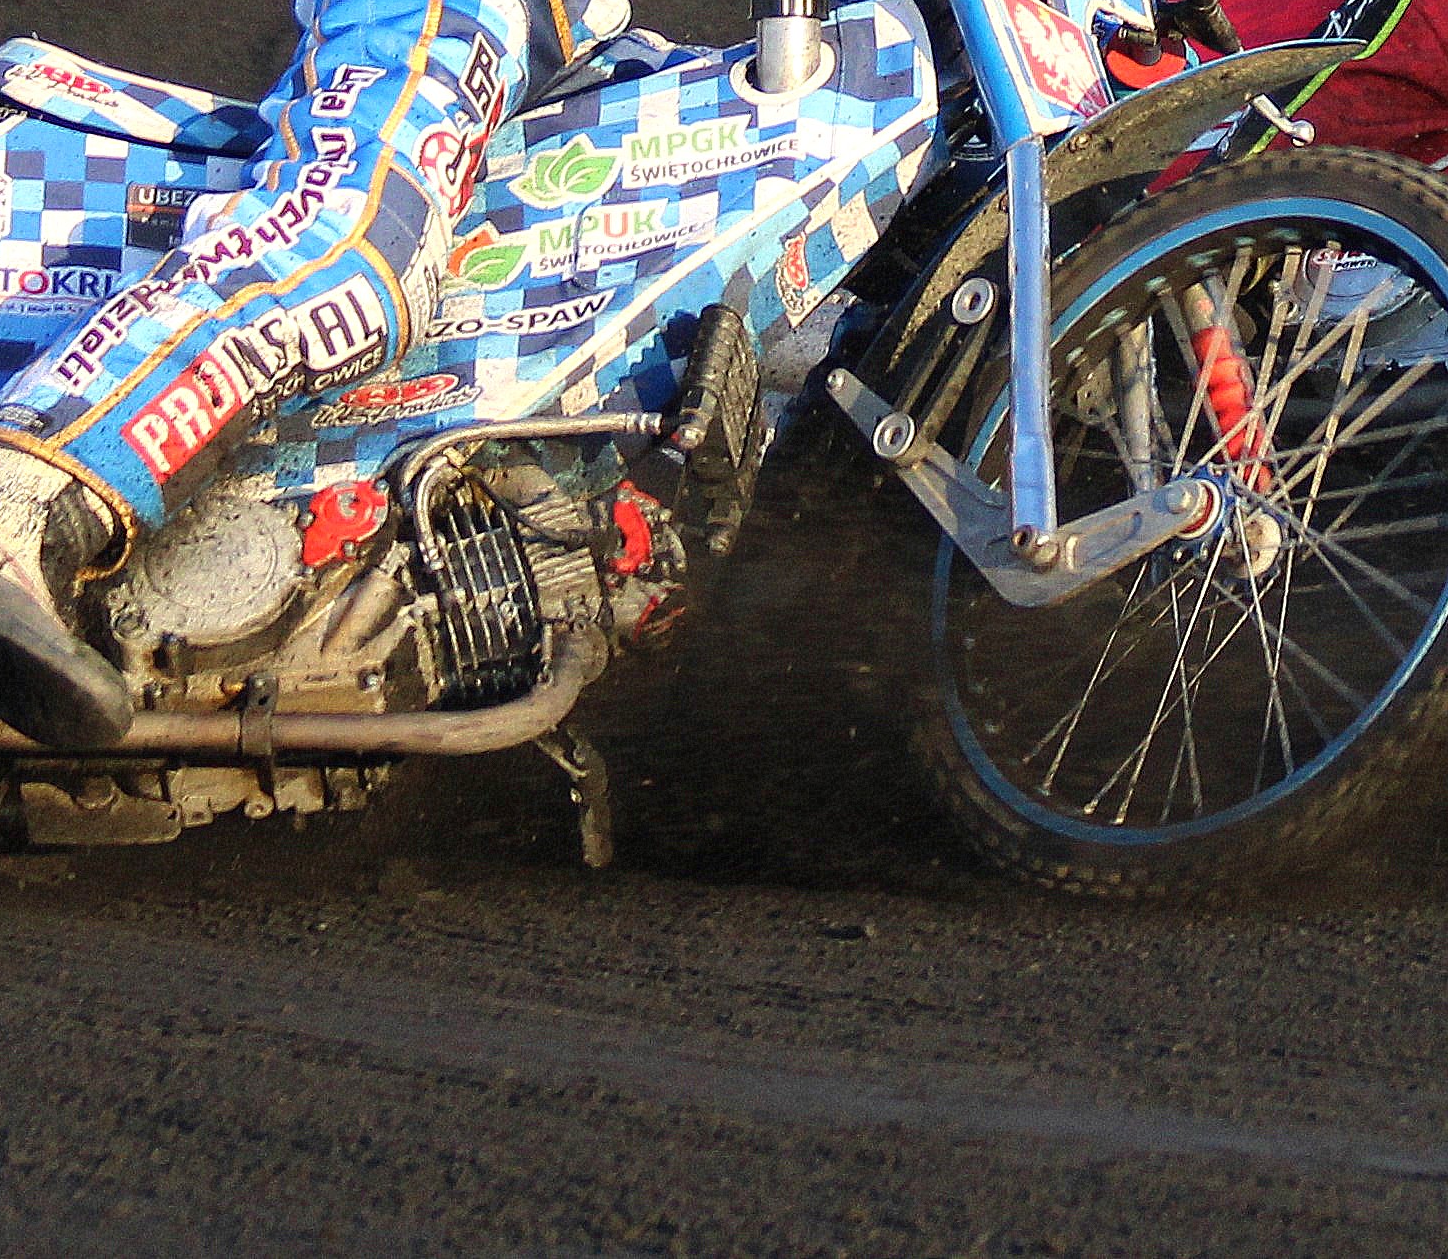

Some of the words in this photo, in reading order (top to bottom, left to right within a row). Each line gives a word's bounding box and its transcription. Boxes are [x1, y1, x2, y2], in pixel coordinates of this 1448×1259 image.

[630, 125, 740, 161] MPGK
[631, 139, 800, 184] ŚWIĘTOCHŁOWICE
[539, 207, 657, 255] MPUK
[539, 221, 703, 272] ŚWITOCHŁOWICE
